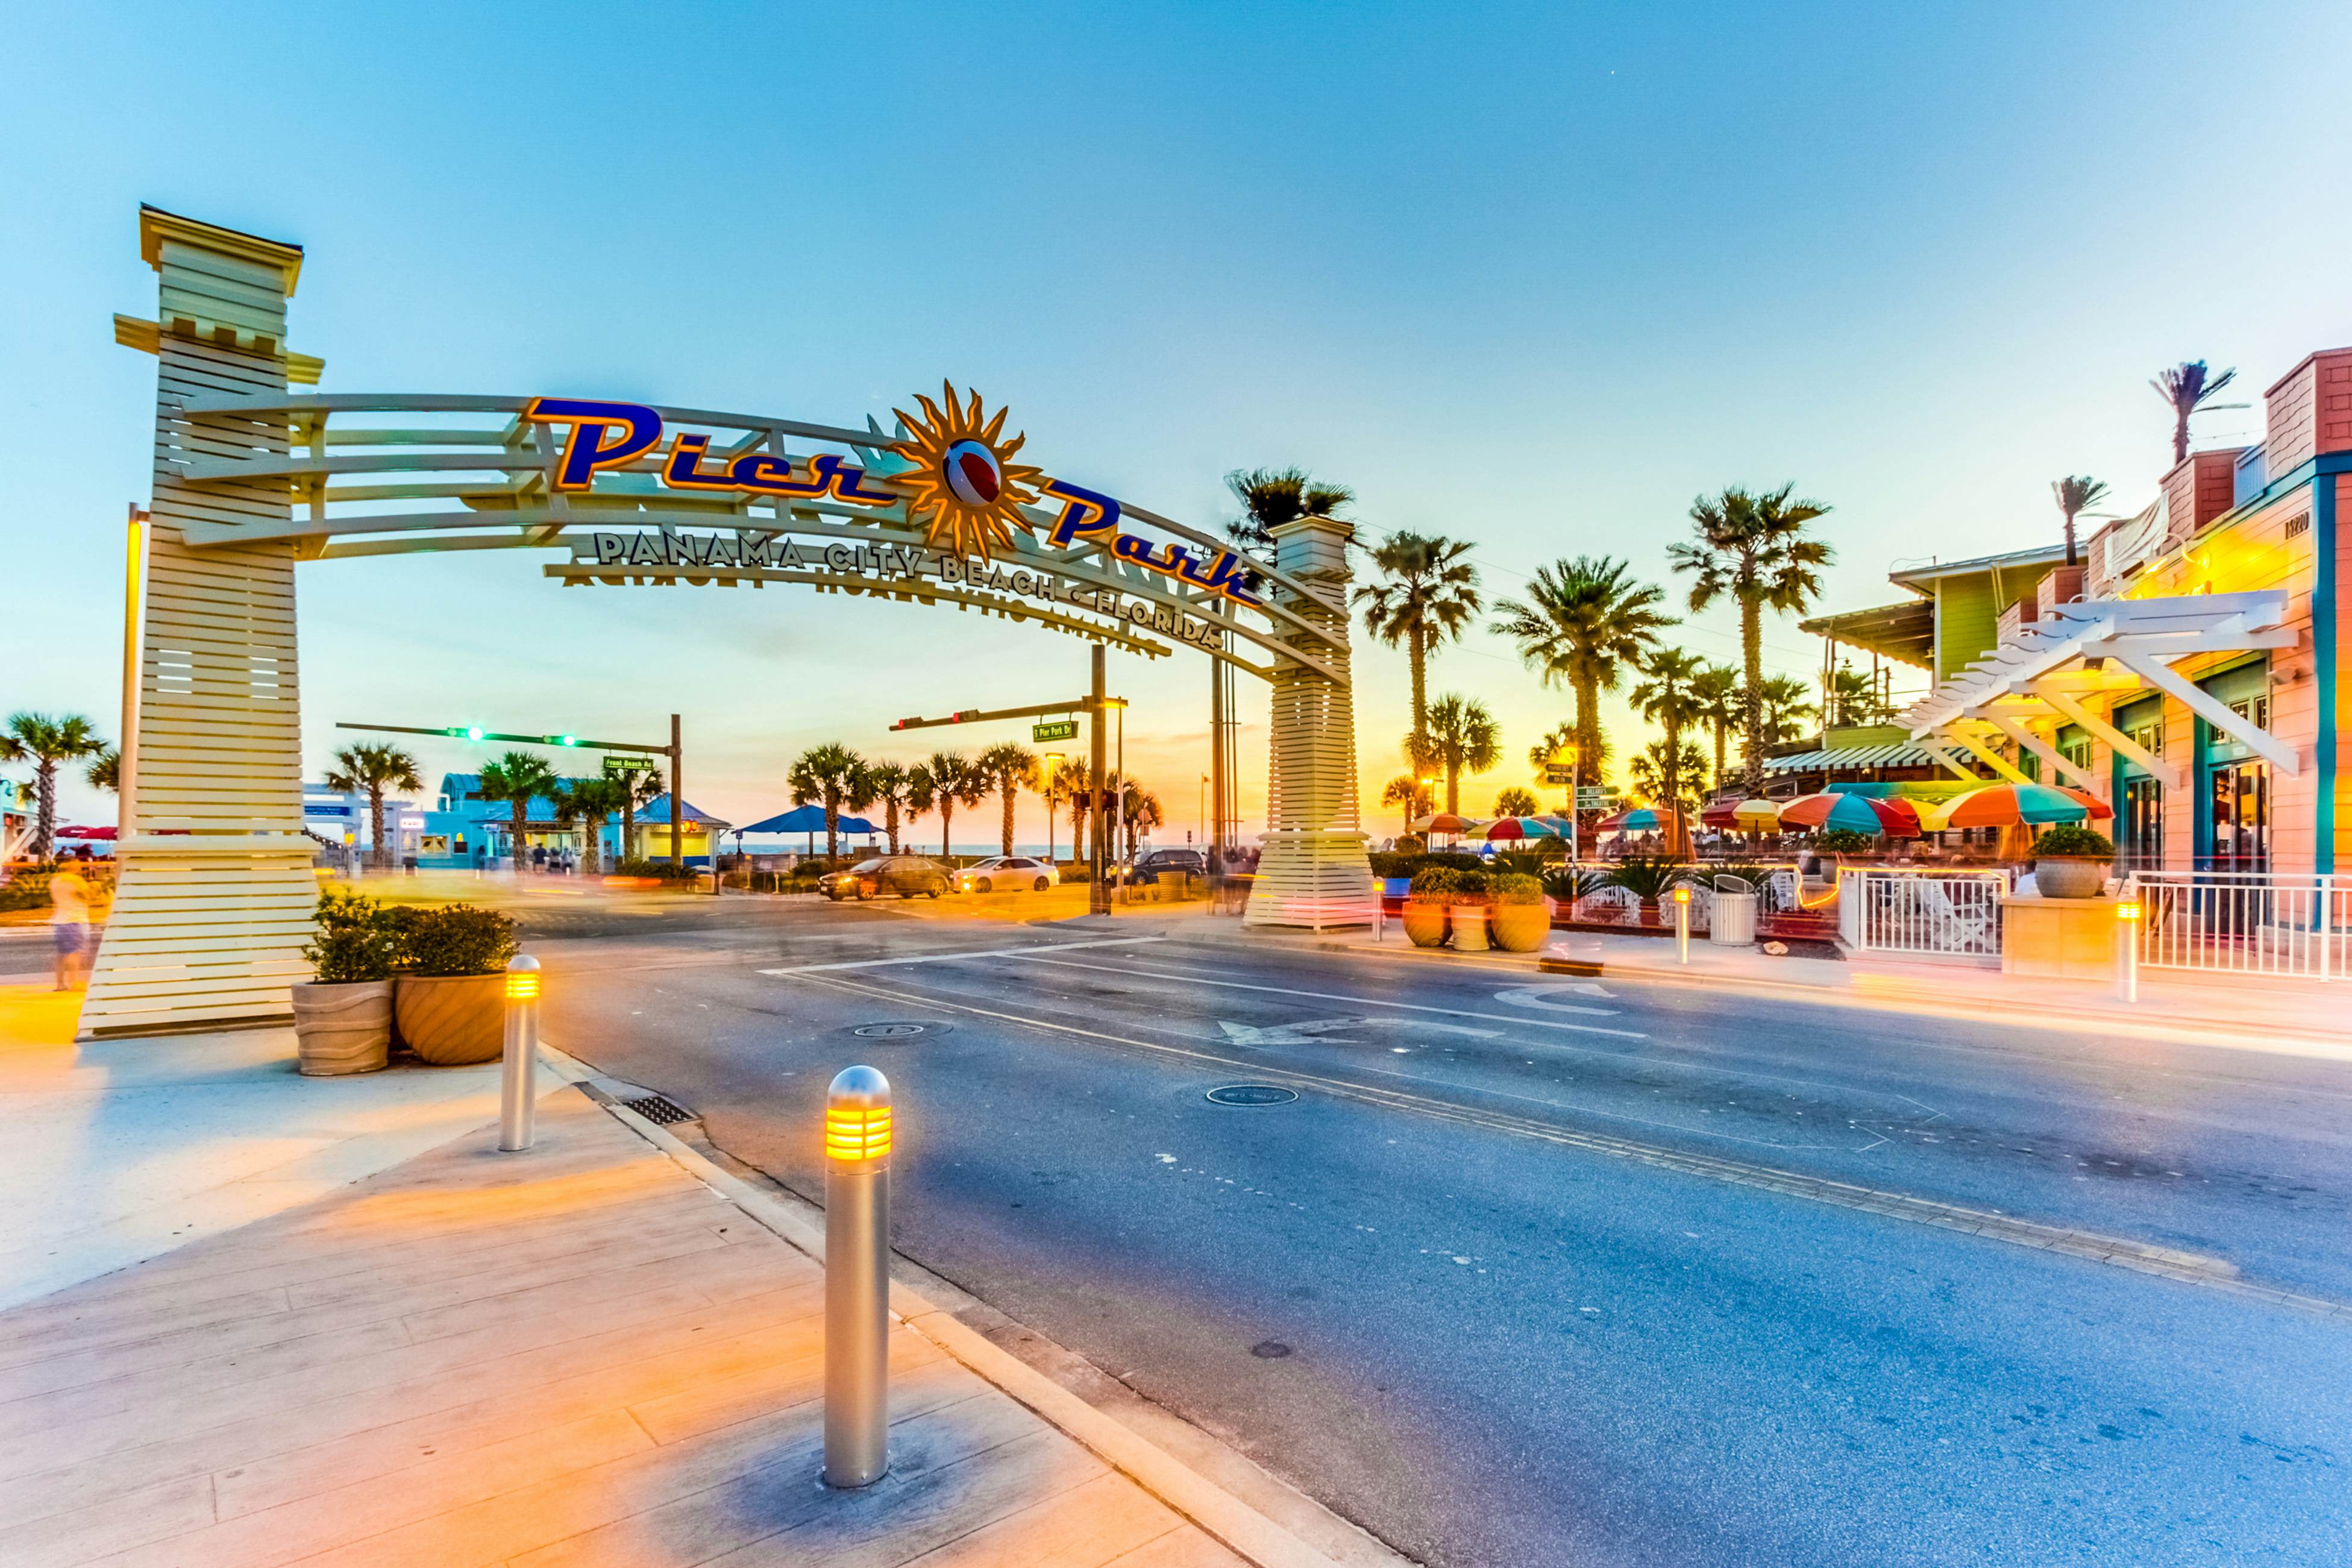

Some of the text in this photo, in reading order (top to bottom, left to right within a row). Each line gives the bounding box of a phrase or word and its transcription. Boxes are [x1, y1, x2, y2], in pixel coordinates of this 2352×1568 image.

[525, 396, 1263, 610] Pier Park
[593, 530, 805, 569] PANAMA
[824, 542, 924, 579] CITY
[941, 555, 1056, 601] BEACH
[1096, 589, 1223, 650] FLORIDA
[1040, 728, 1049, 737] Pier
[1051, 726, 1062, 736] Park
[1064, 725, 1070, 735] Dr
